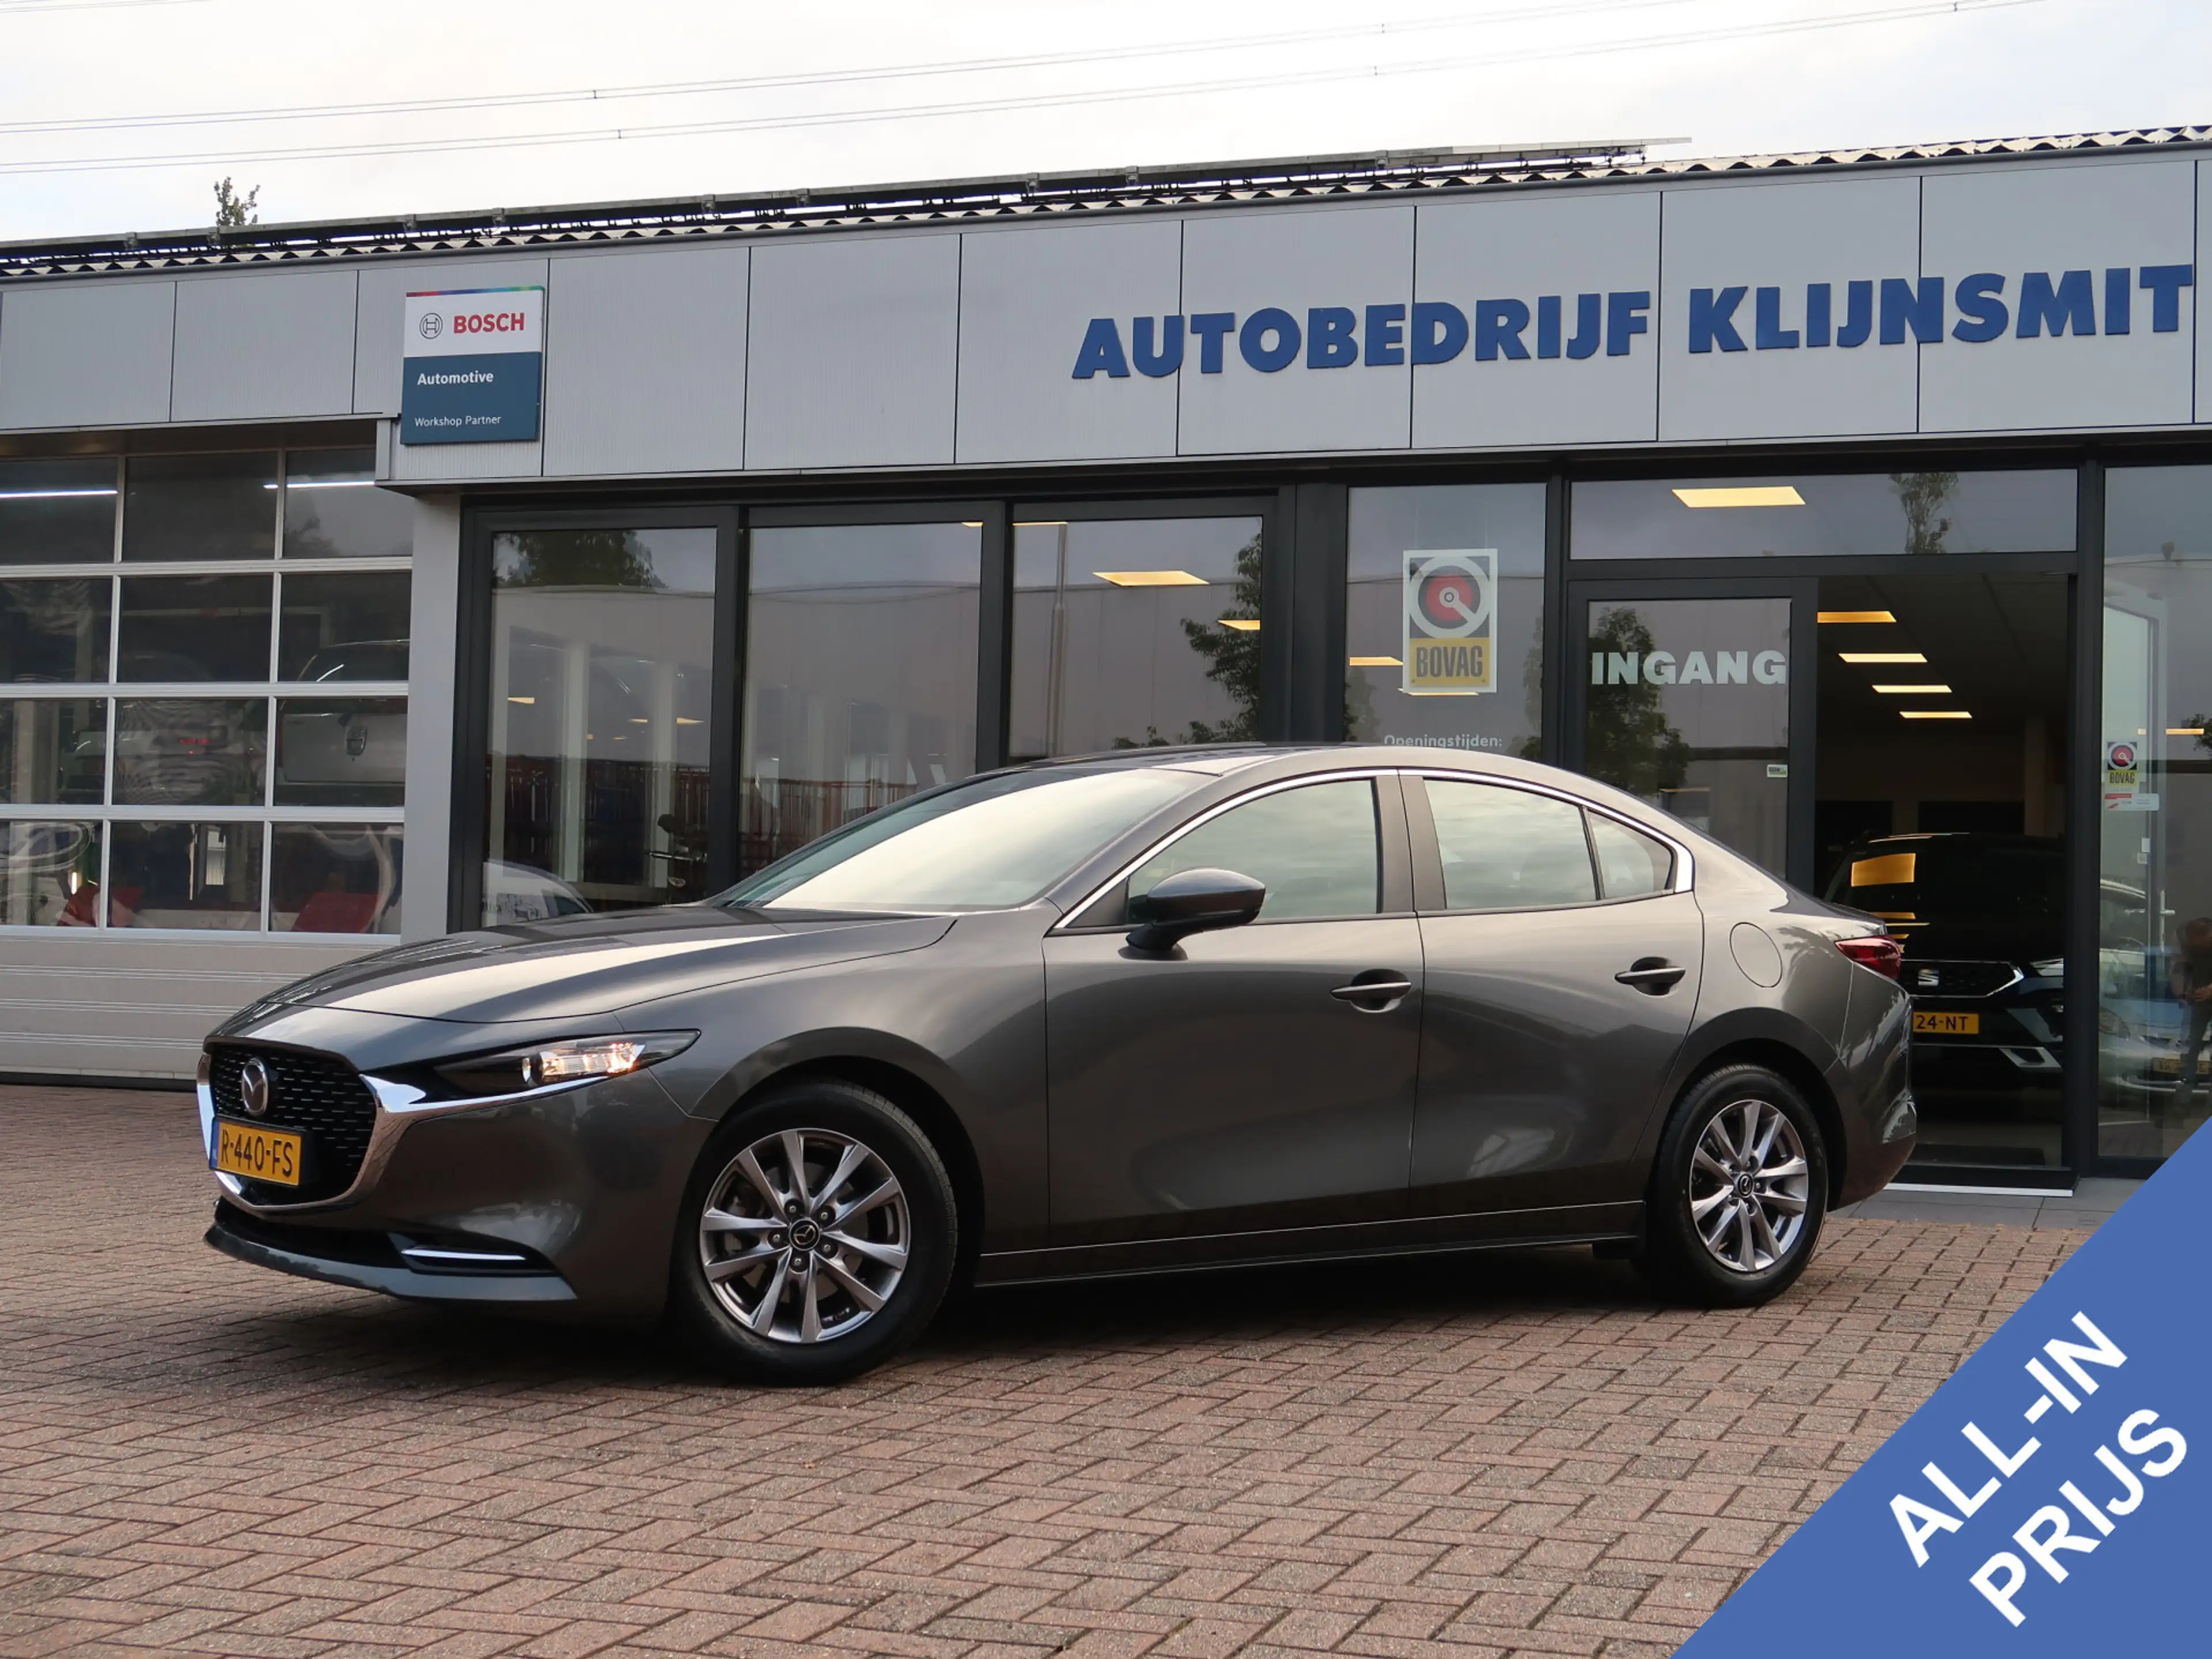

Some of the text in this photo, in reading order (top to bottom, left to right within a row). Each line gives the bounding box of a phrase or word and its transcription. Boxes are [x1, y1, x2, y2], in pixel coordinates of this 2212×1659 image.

[453, 313, 525, 334] BOSCH
[1072, 264, 2193, 379] AUTOBEDRIJF KLIJNSMIT
[417, 370, 494, 385] Automotive
[415, 415, 502, 427] Workshop Partner
[1416, 645, 1483, 678] BOVAG
[1592, 650, 1786, 685] INGANG
[2109, 772, 2135, 784] BOVAG
[221, 1128, 294, 1178] R-440-FS
